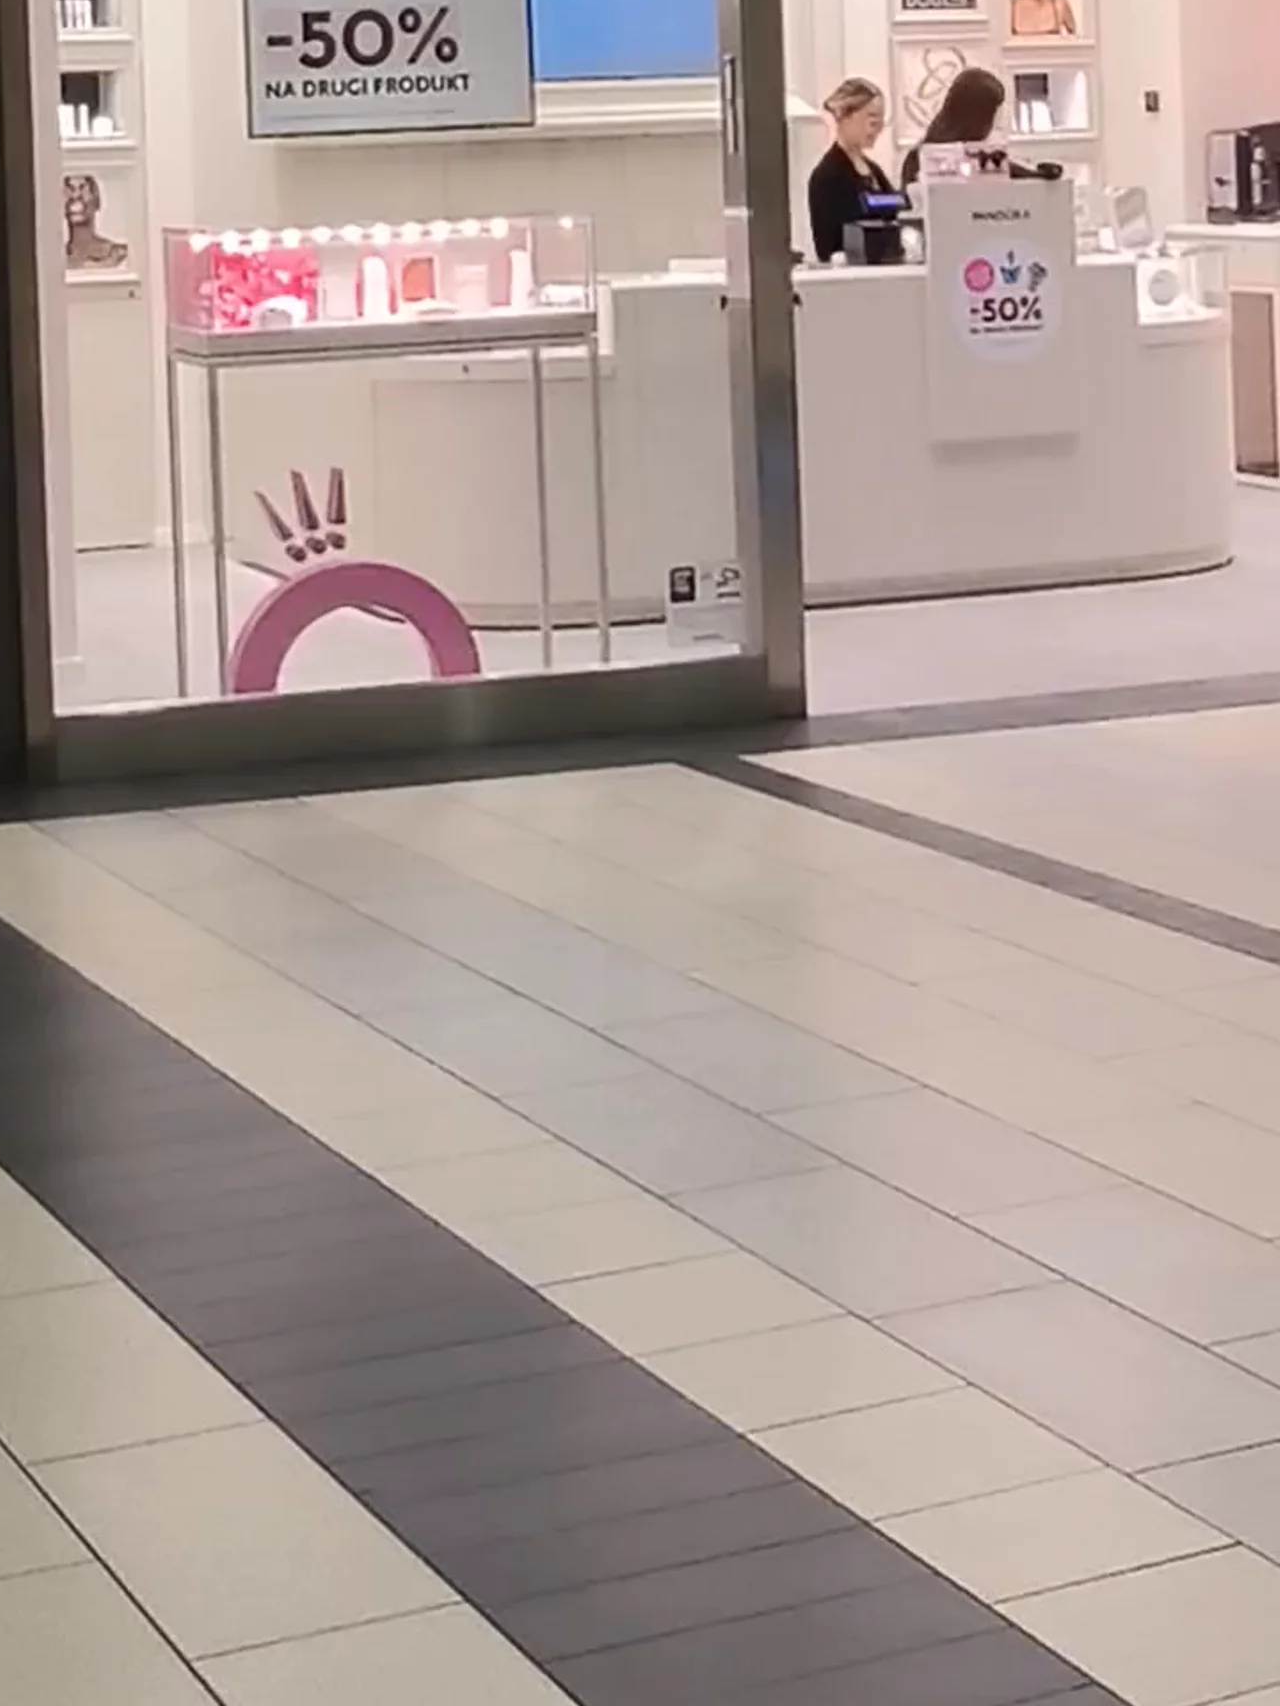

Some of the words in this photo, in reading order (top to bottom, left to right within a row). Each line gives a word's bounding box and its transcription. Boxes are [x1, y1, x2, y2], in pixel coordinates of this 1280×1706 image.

[267, 6, 459, 68] -50%
[266, 81, 296, 99] NA
[970, 296, 1042, 322] -50%
